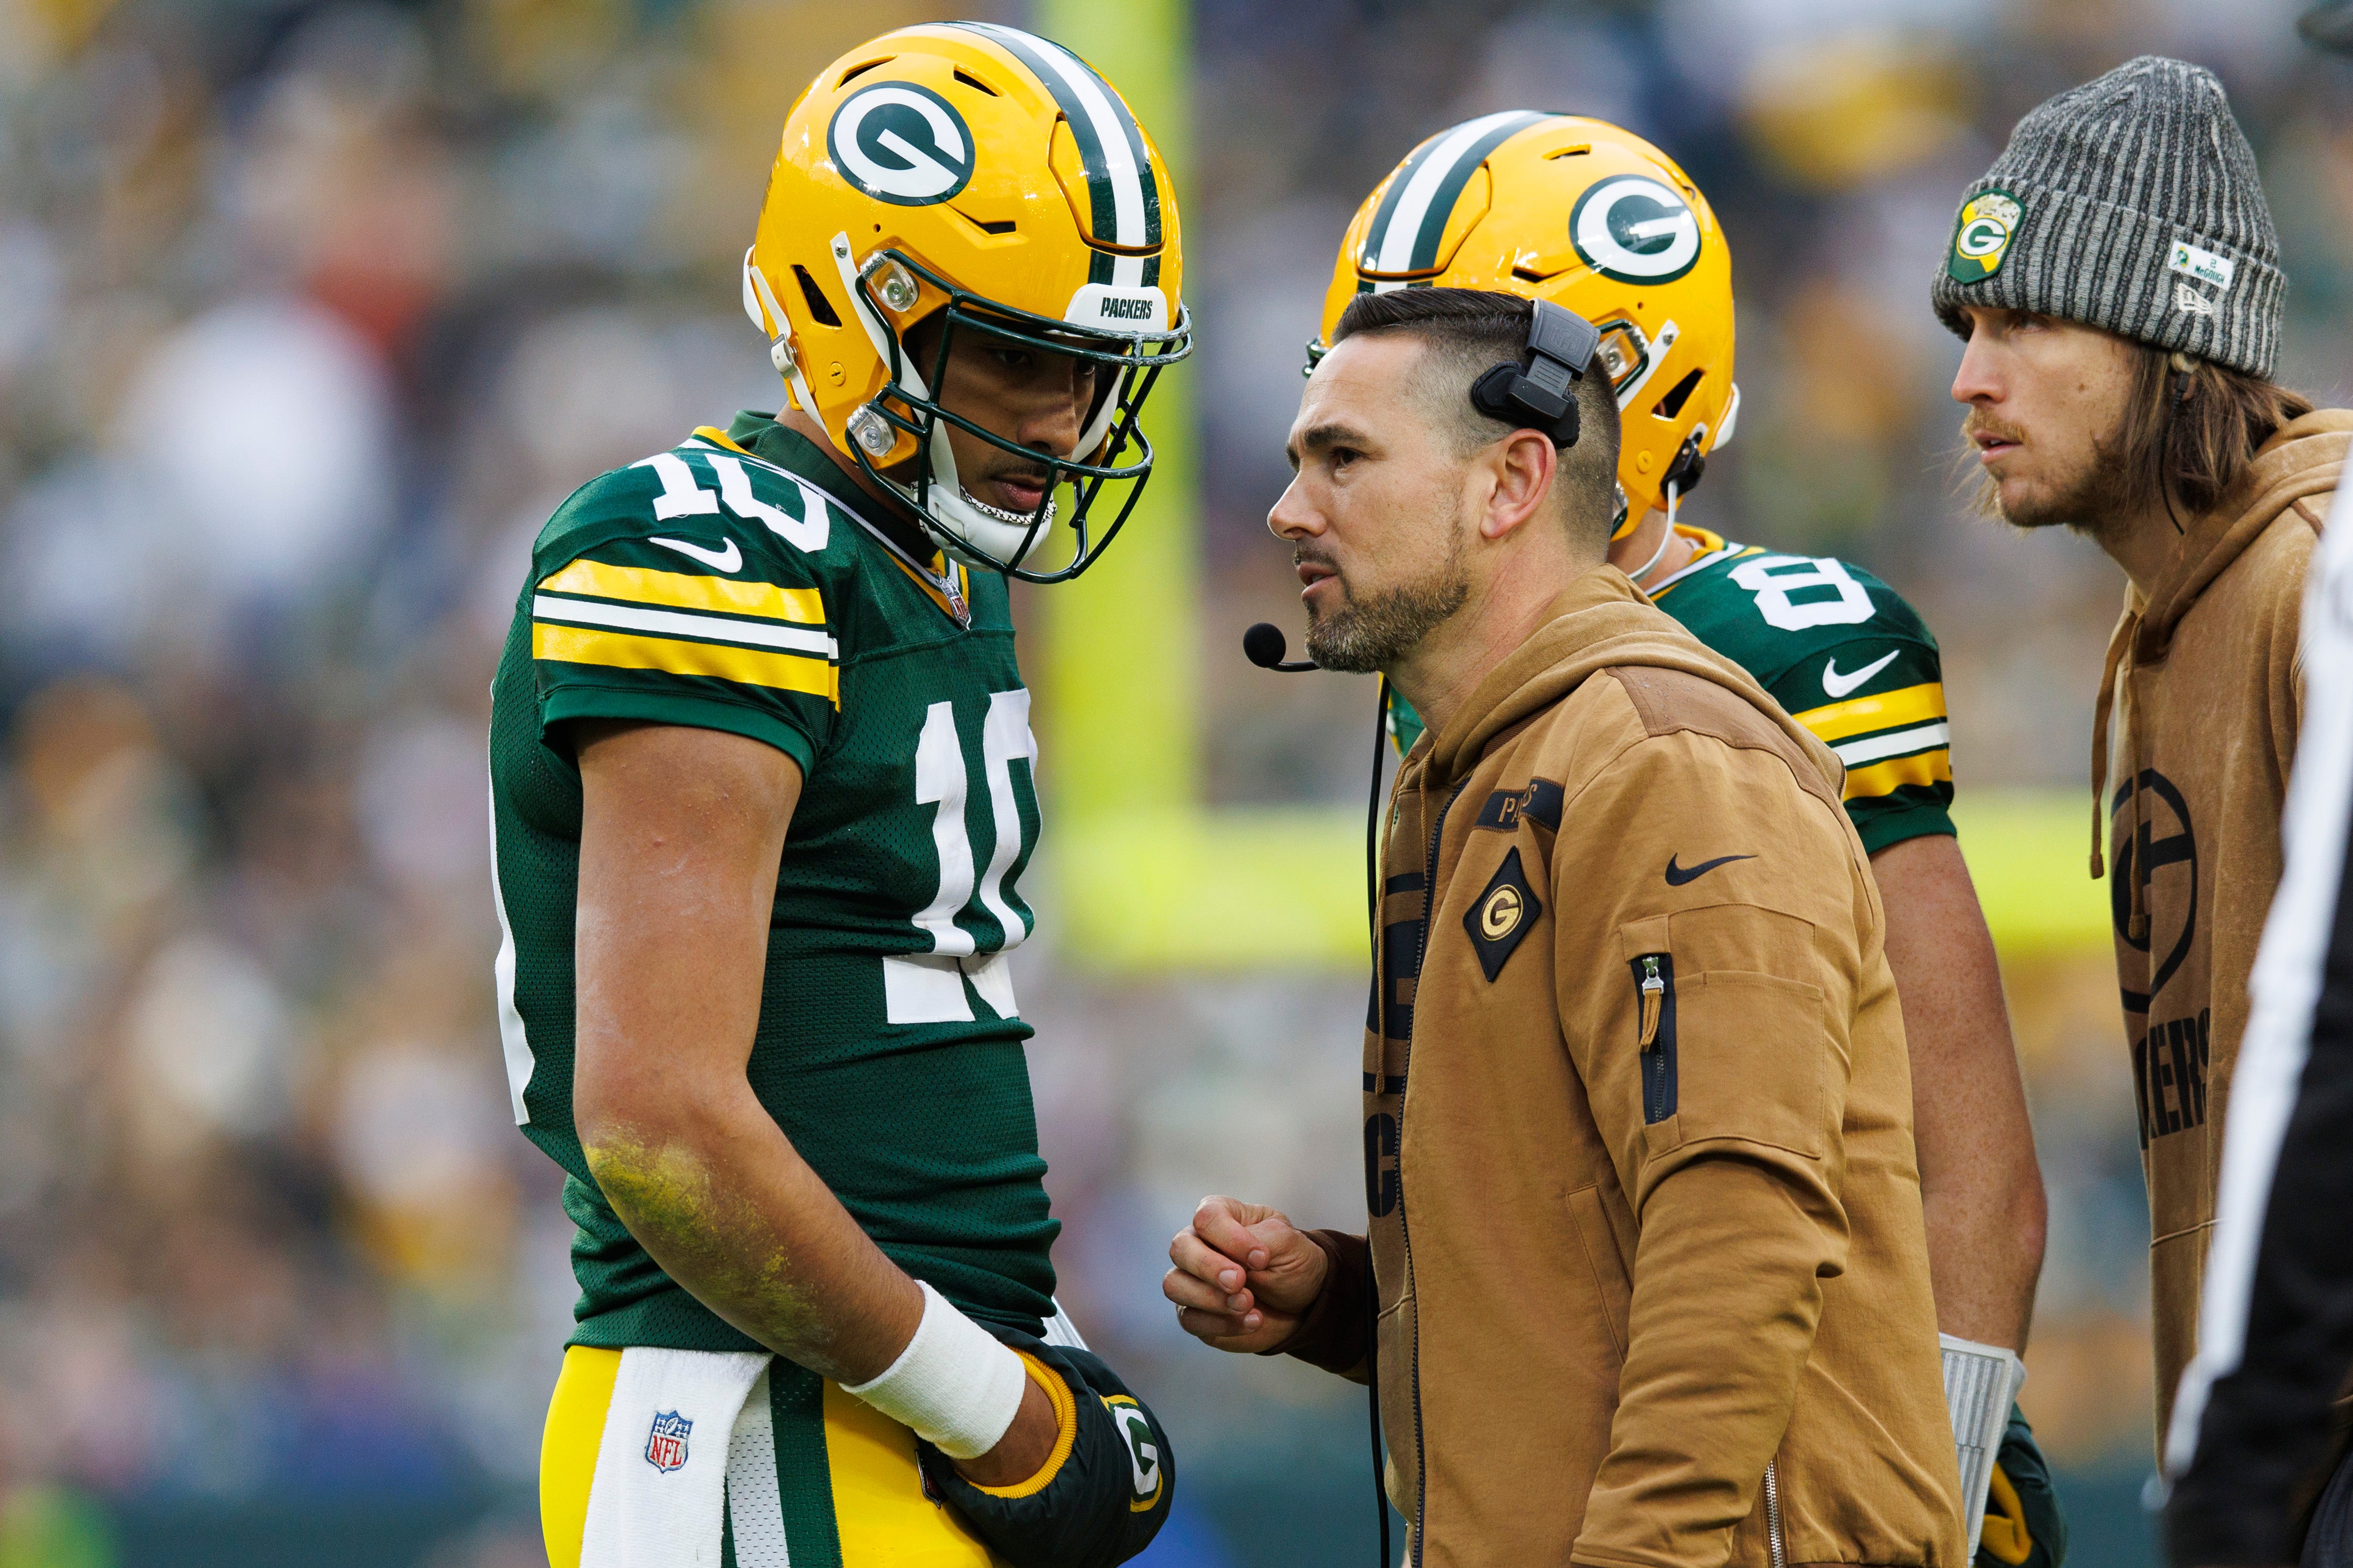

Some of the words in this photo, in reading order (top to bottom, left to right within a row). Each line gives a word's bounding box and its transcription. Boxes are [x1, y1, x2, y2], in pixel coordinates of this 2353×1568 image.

[834, 87, 966, 198] G
[1577, 179, 1699, 277] G
[1959, 219, 2007, 256] G
[1100, 297, 1153, 320] PACKERS
[627, 452, 830, 553] 10
[1727, 556, 1876, 632] 8
[883, 688, 1042, 1024] 10
[1481, 885, 1522, 940] G
[650, 1434, 682, 1467] NFL
